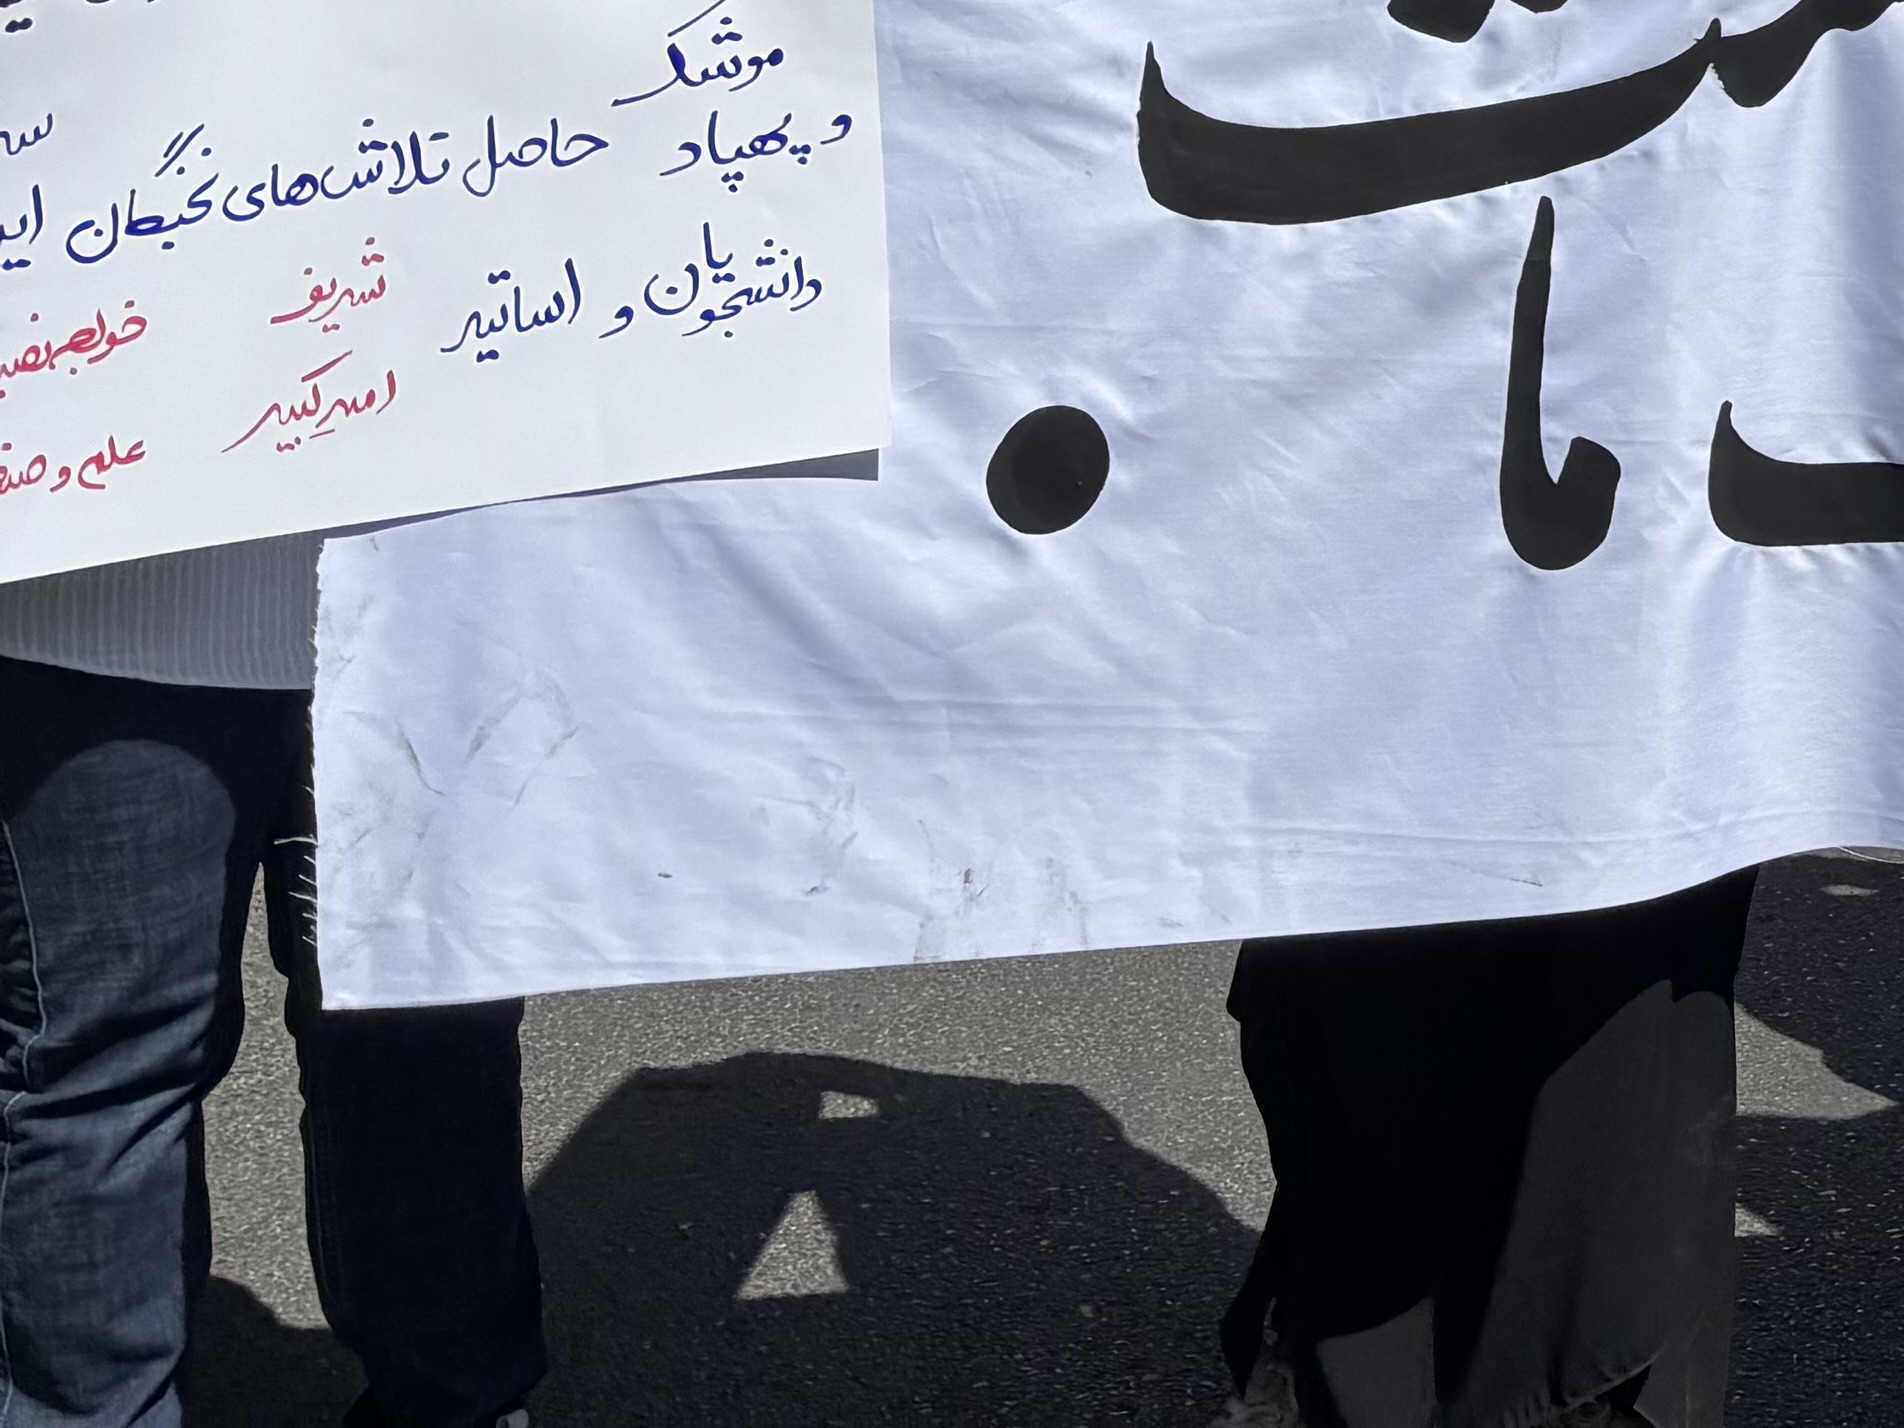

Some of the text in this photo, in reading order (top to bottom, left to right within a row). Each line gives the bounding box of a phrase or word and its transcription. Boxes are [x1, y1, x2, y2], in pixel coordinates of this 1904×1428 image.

[461, 114, 609, 199] حاصل
[660, 110, 813, 194] پهپاد
[820, 112, 854, 148] و
[65, 125, 216, 263] نخبگان
[270, 237, 387, 332] شریف
[600, 305, 635, 340] و
[49, 466, 71, 493] و
[77, 433, 146, 490] علم
